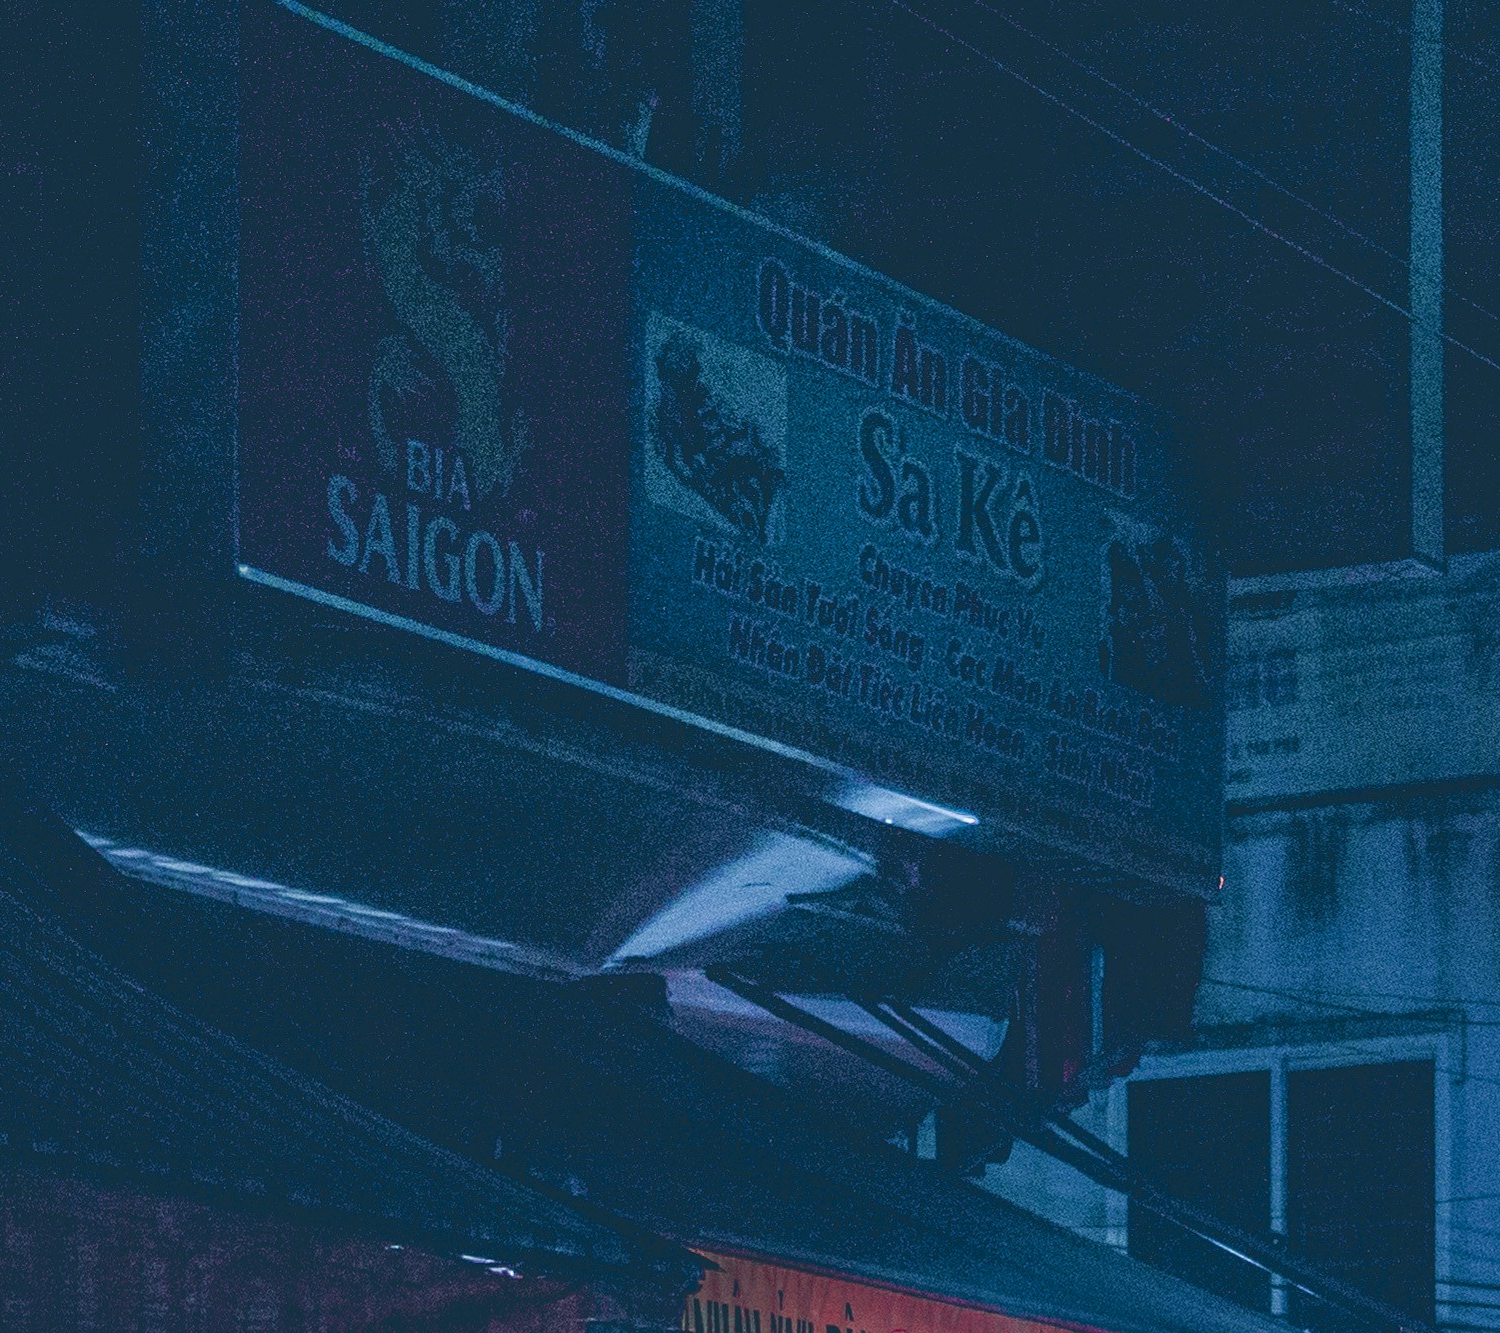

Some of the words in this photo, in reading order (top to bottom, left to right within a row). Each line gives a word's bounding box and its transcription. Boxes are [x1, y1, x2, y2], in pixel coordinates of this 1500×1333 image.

[757, 256, 880, 389] Quán
[959, 351, 1031, 455] Gia
[327, 473, 545, 633] SAIGON
[407, 438, 471, 512] BIA
[857, 407, 938, 546] Sa
[954, 442, 1044, 585] Kê
